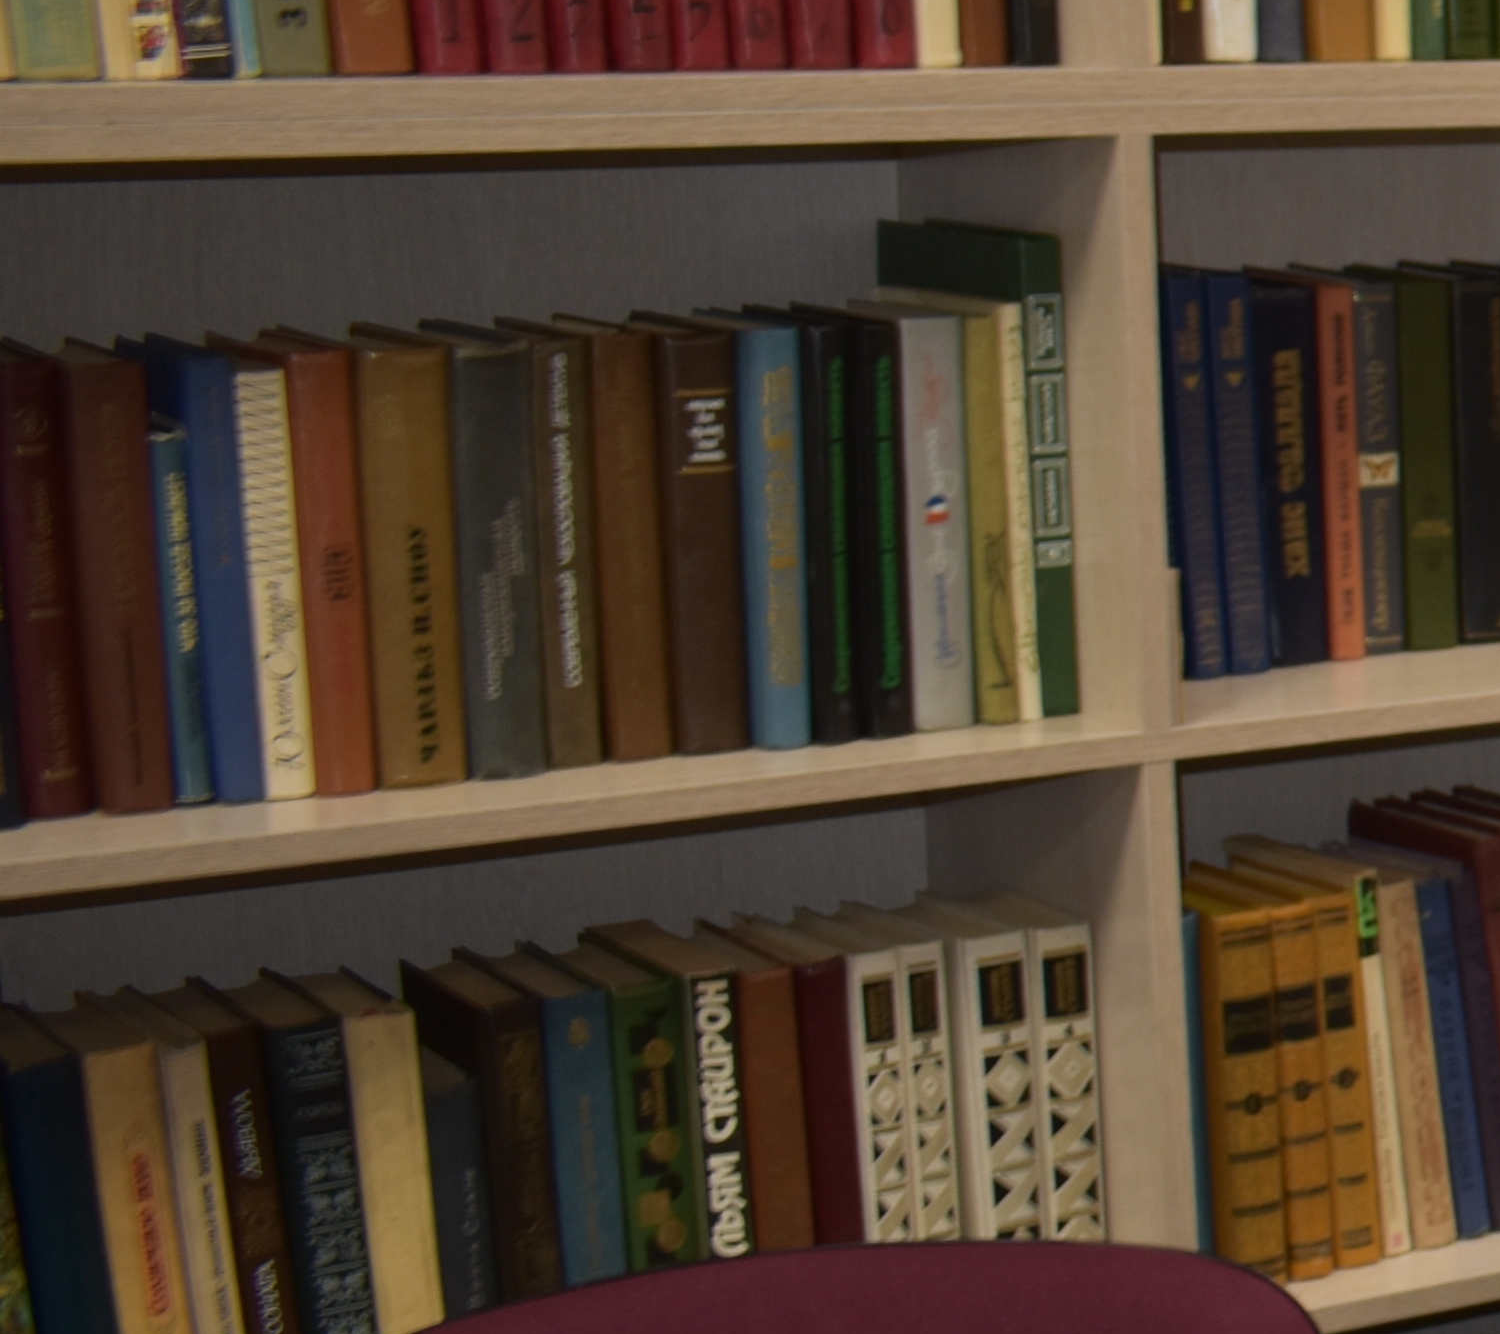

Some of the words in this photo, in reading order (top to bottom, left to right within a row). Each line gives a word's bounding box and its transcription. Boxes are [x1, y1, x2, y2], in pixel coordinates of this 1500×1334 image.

[689, 977, 741, 1143] СТАЙРОН
[227, 1087, 264, 1178] ДЬЯВОЛА
[706, 1149, 750, 1257] ЛЬЯМ
